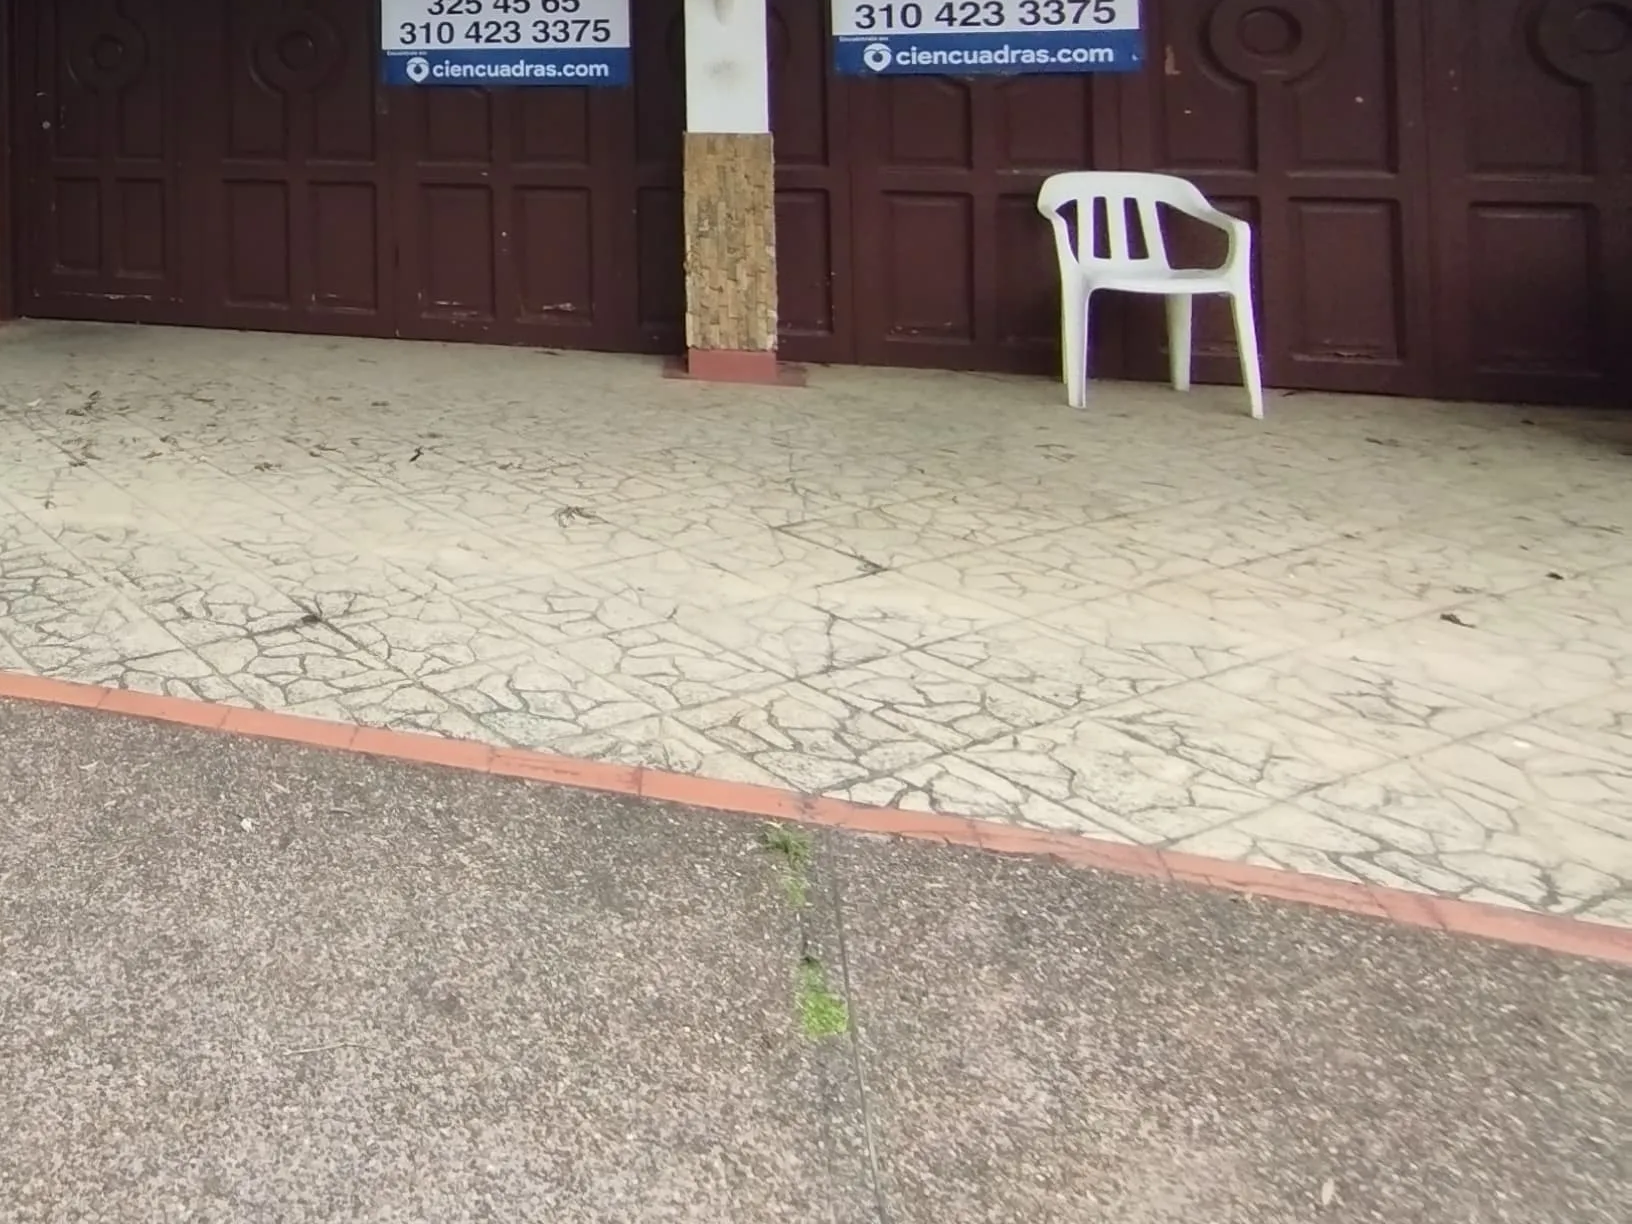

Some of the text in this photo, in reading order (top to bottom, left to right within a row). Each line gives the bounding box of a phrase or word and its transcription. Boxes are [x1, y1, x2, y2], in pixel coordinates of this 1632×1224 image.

[855, 2, 922, 29] 310
[935, 1, 1005, 27] 423
[399, 18, 611, 45] 310 423 3375
[896, 44, 1114, 66] ciencuadras.com
[433, 58, 609, 78] ciencuadras.com
